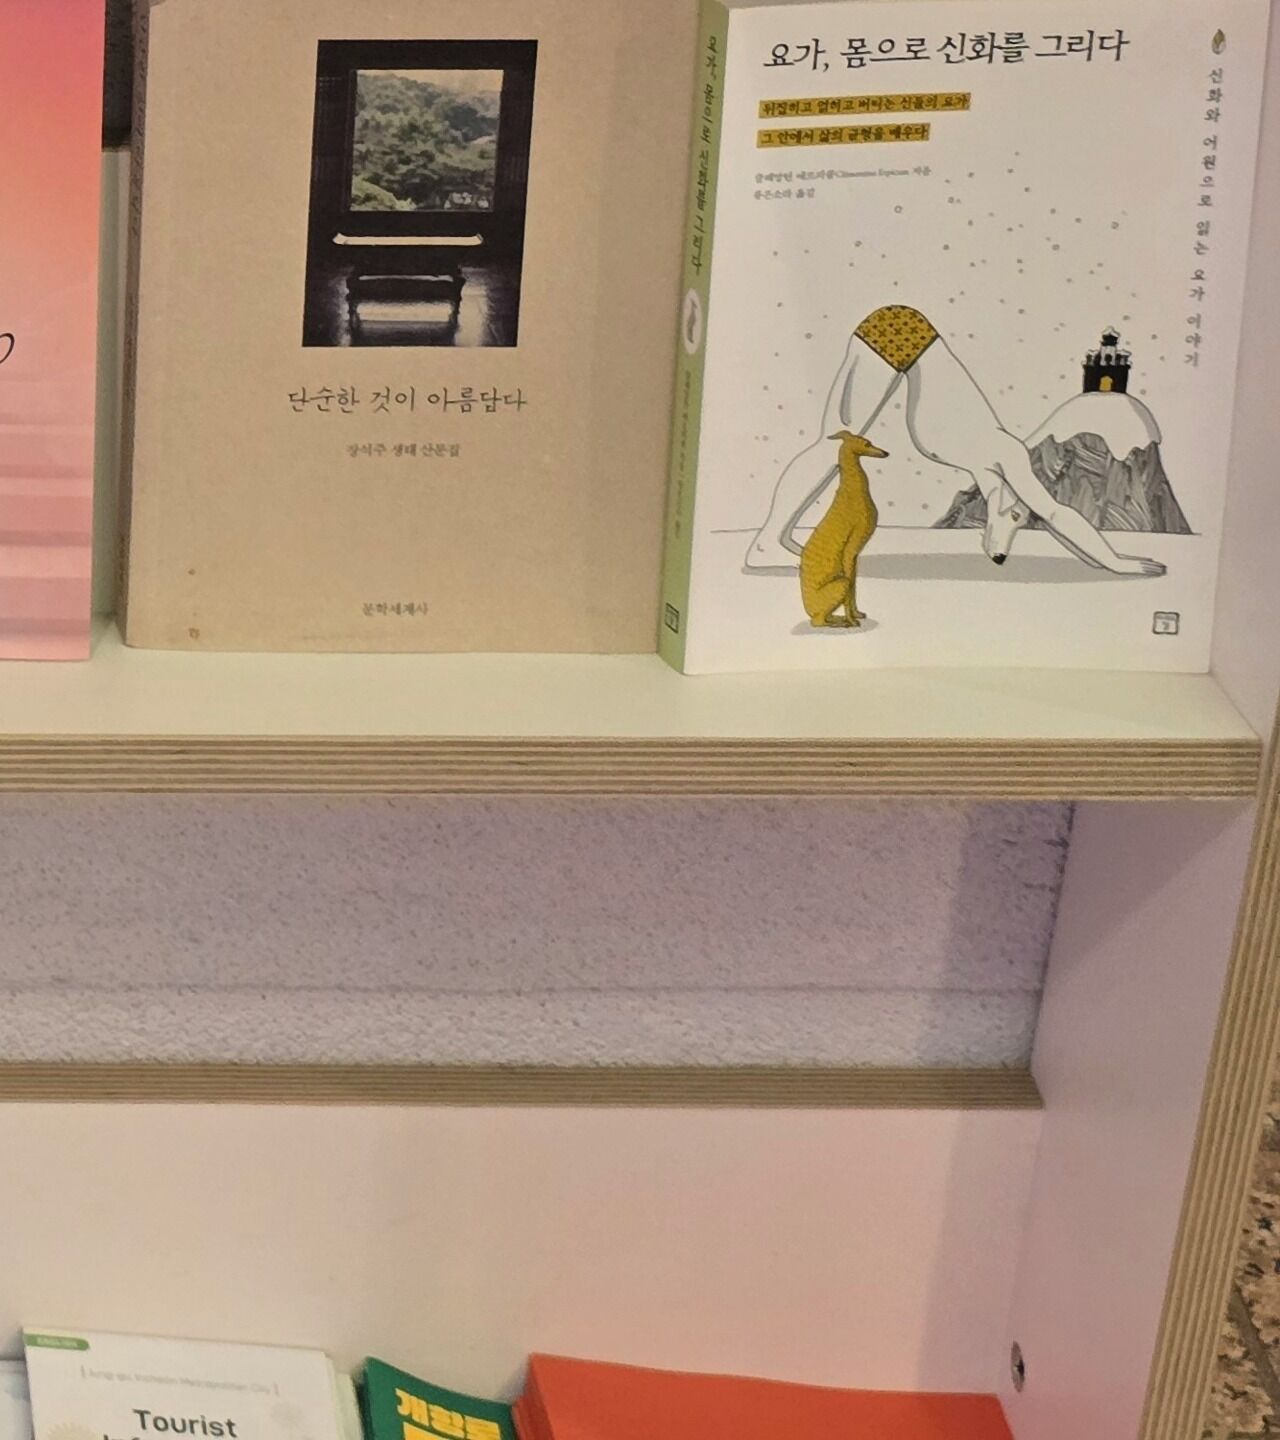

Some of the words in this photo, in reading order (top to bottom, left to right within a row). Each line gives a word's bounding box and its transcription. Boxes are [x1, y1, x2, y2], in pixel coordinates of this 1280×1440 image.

[762, 37, 831, 72] 요가,
[839, 35, 931, 69] 몸으로
[936, 31, 1032, 66] 신화를
[1034, 28, 1131, 63] 그리다
[941, 93, 969, 109] 요가
[760, 132, 774, 145] 그
[286, 385, 361, 416] 단순한
[370, 385, 417, 415] 것이
[427, 385, 528, 416] 아름답다
[132, 1408, 238, 1439] Tourist
